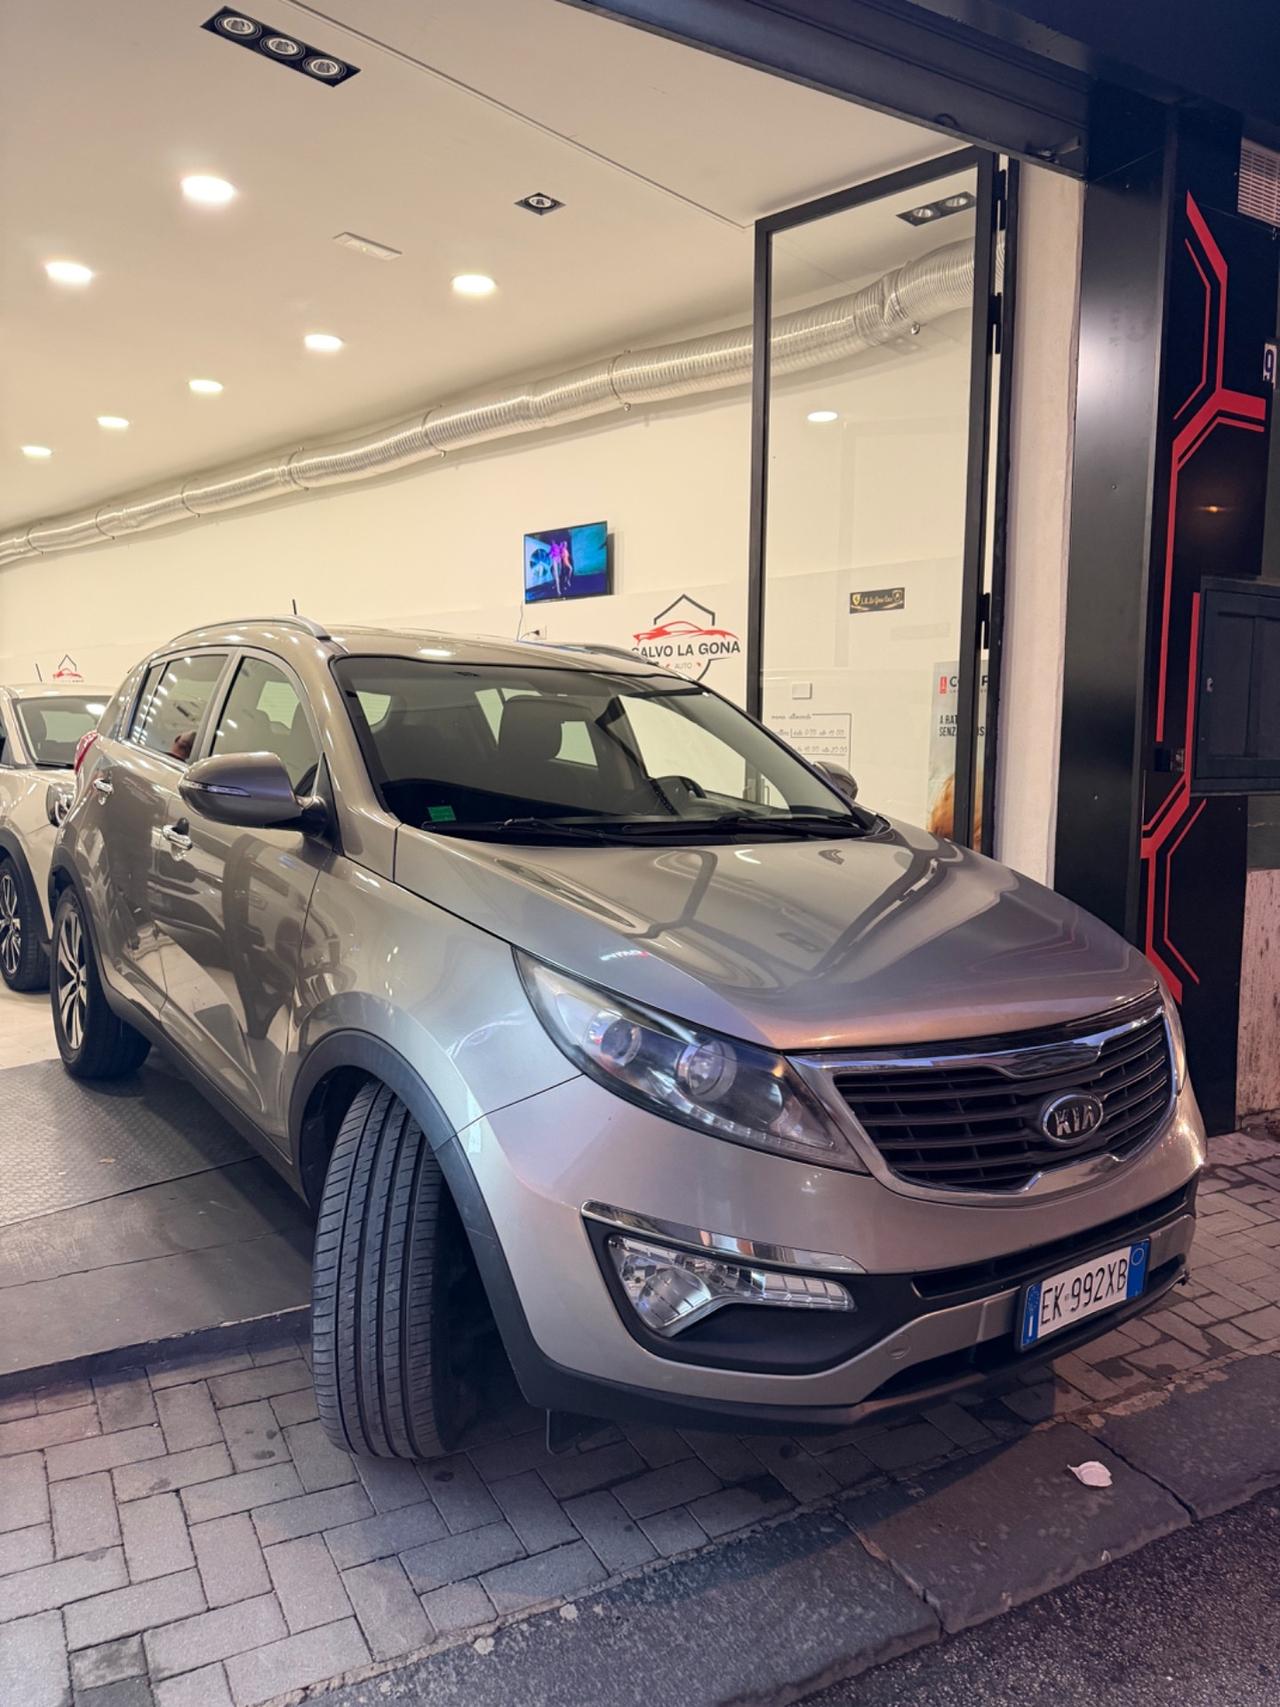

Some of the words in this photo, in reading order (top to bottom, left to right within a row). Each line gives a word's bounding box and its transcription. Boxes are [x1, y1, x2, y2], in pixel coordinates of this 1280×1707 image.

[632, 645, 673, 658] ALVO
[678, 644, 694, 656] LA
[698, 641, 741, 655] GONA
[674, 662, 693, 670] AUTO
[1055, 1105, 1094, 1136] KIA
